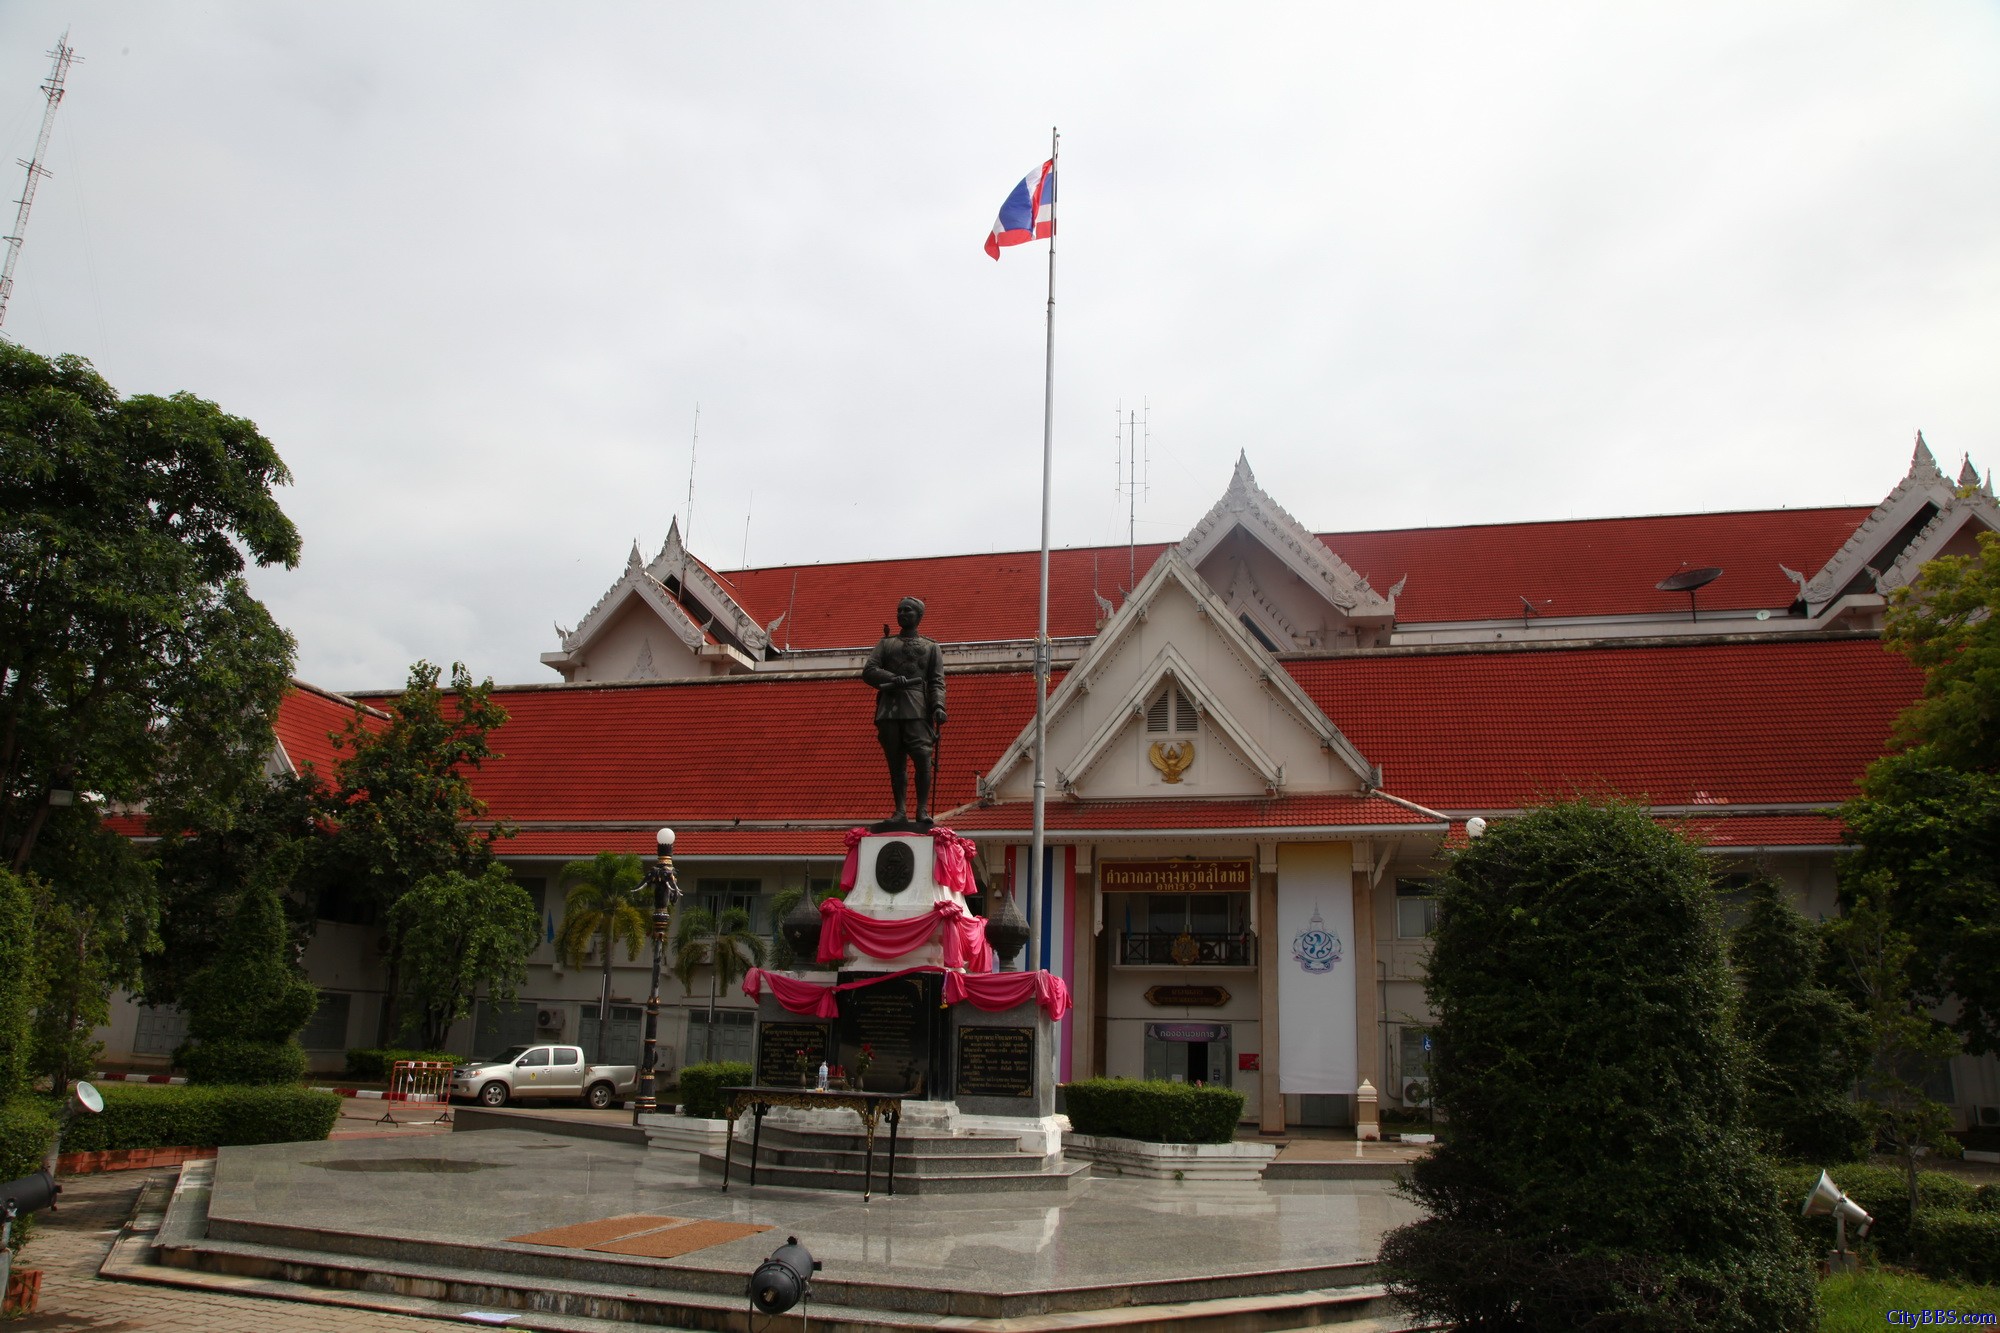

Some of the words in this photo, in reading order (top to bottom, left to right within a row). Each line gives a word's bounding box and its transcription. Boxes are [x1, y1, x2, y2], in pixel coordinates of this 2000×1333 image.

[1106, 863, 1246, 890] ศาลากลางจังหวัดสุโขทัย
[1160, 1027, 1215, 1038] กองอำนวยการ
